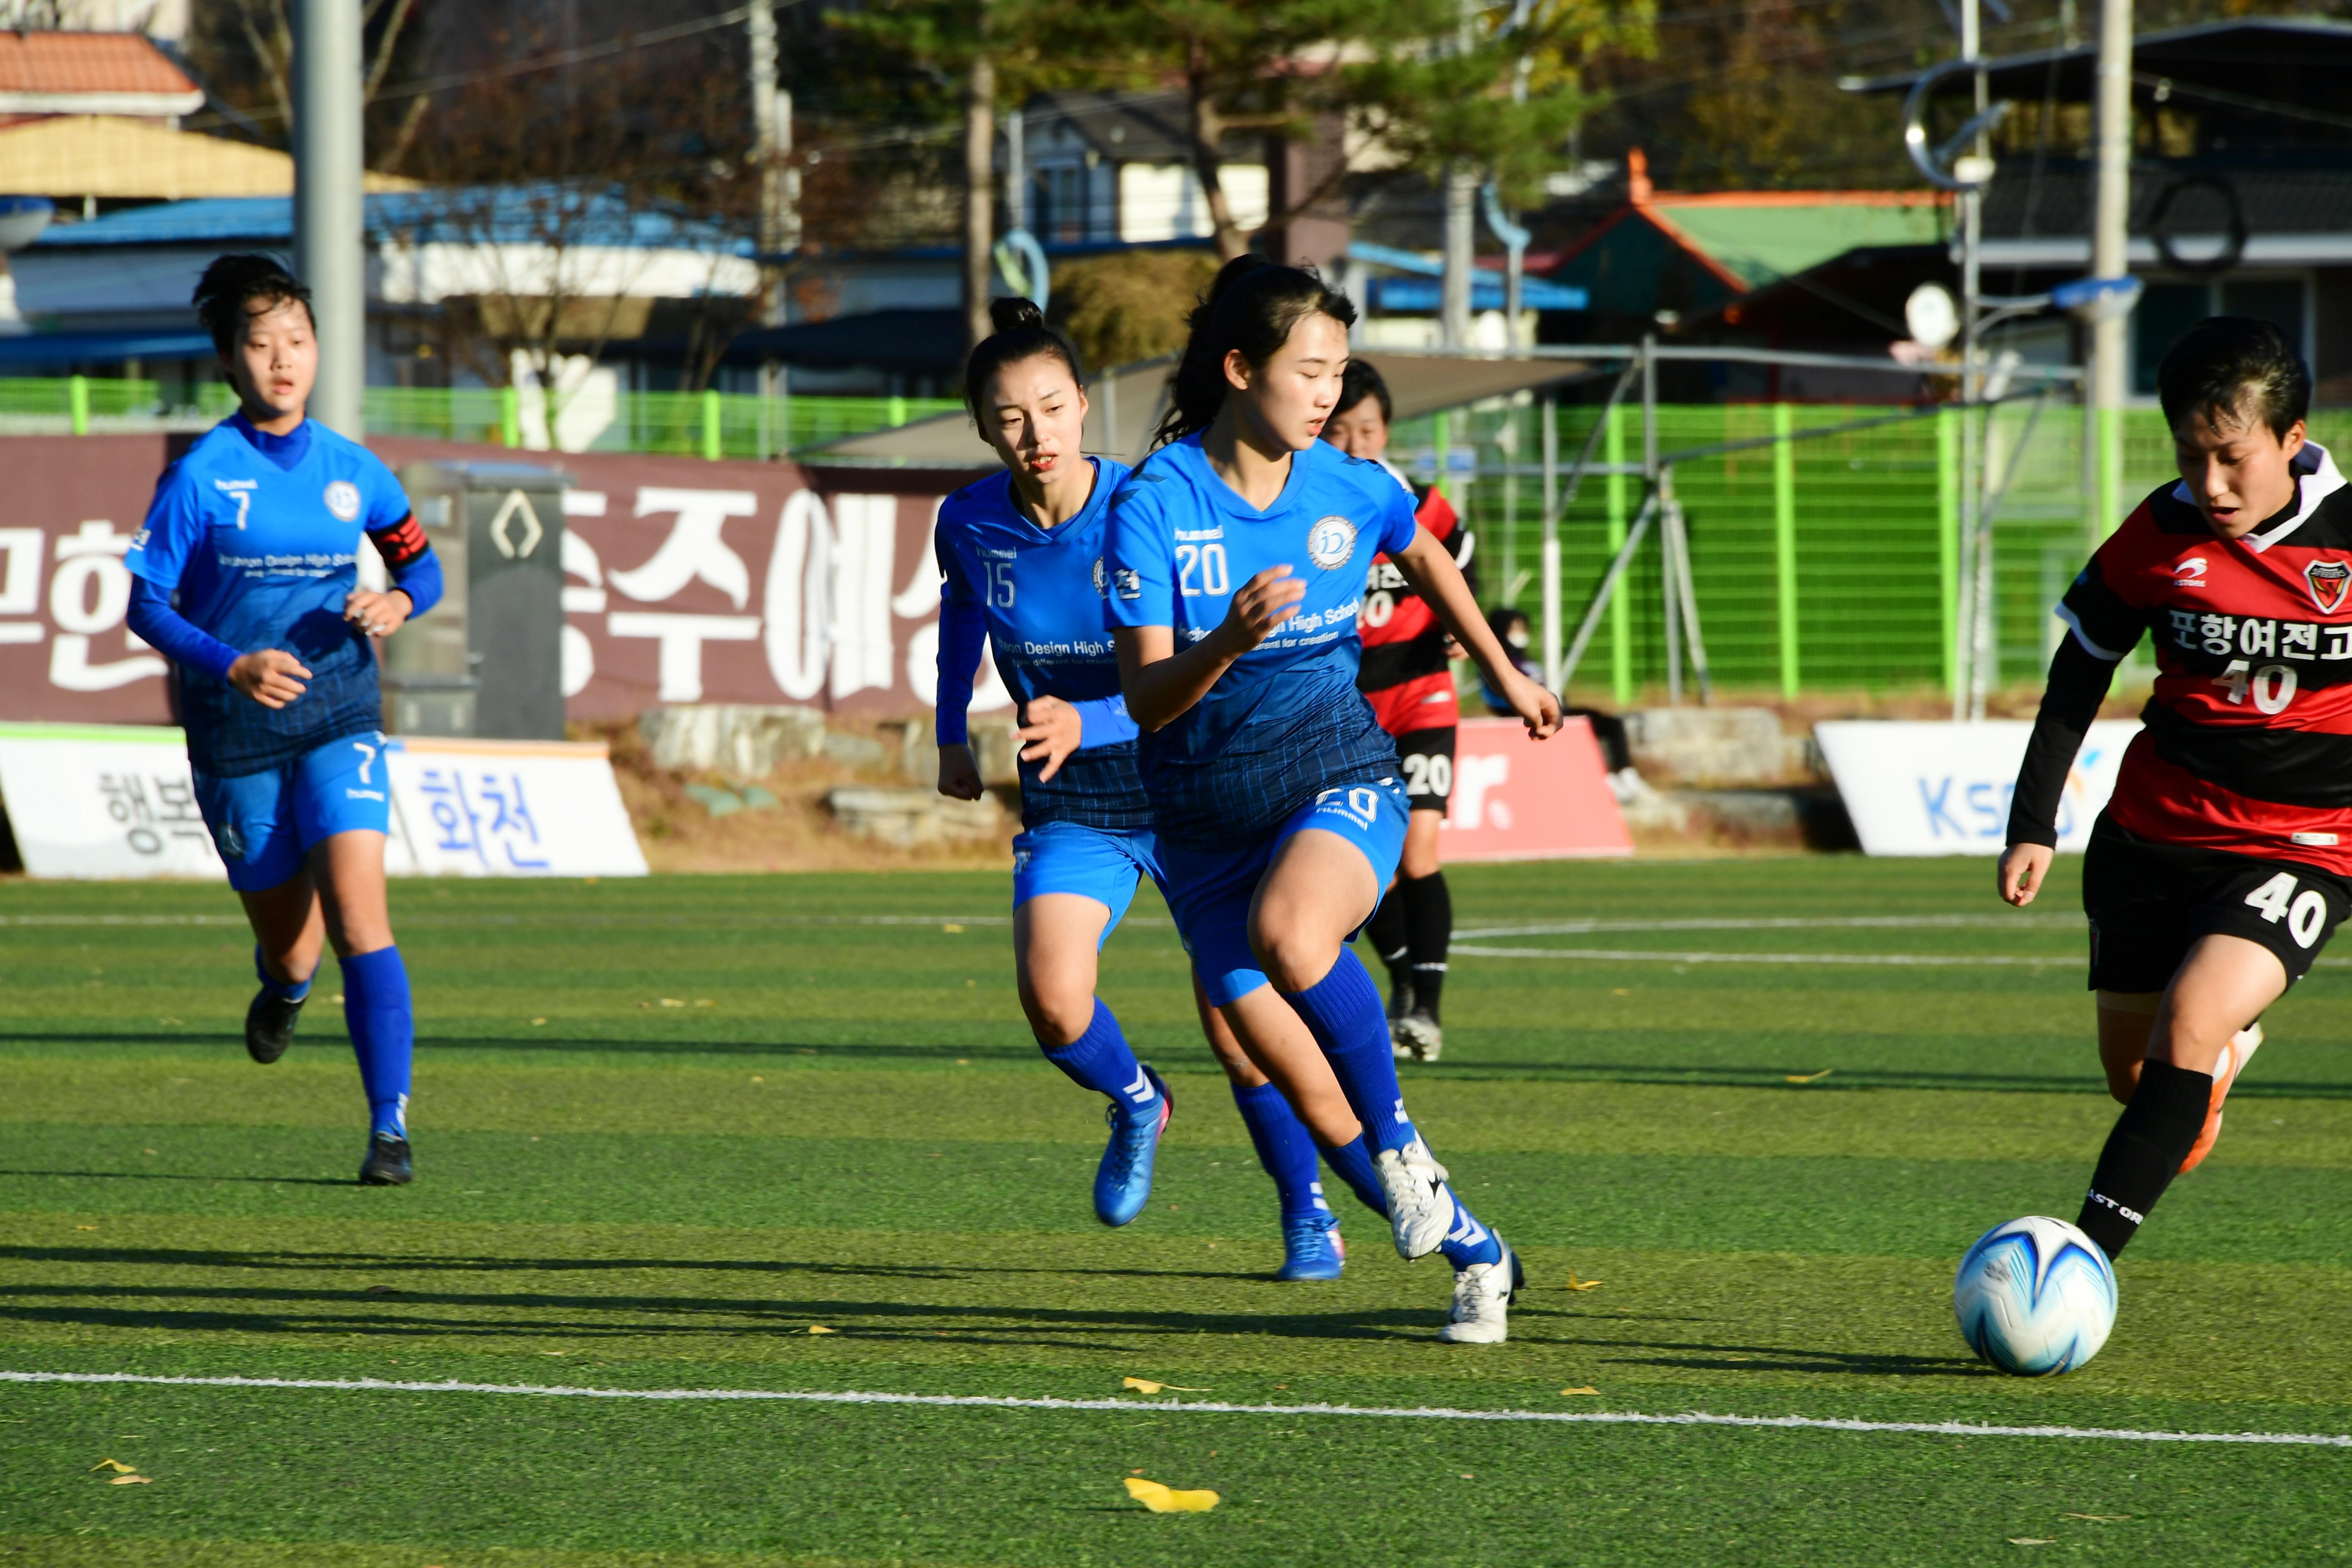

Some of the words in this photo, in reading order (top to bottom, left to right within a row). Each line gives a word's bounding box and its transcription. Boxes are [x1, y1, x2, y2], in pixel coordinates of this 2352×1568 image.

[229, 490, 250, 530] 7
[976, 547, 1017, 559] hummel
[1174, 525, 1223, 541] hummel
[983, 561, 1015, 608] 15
[1175, 543, 1230, 596] 20
[1288, 612, 1323, 633] High
[2170, 610, 2352, 661] 포항여전고
[1024, 640, 1070, 656] Design
[1073, 640, 1105, 657] High
[2211, 659, 2298, 715] 40
[353, 742, 376, 784] 7
[1403, 753, 1452, 797] 20
[421, 770, 550, 869] 화천
[2244, 871, 2327, 949] 40
